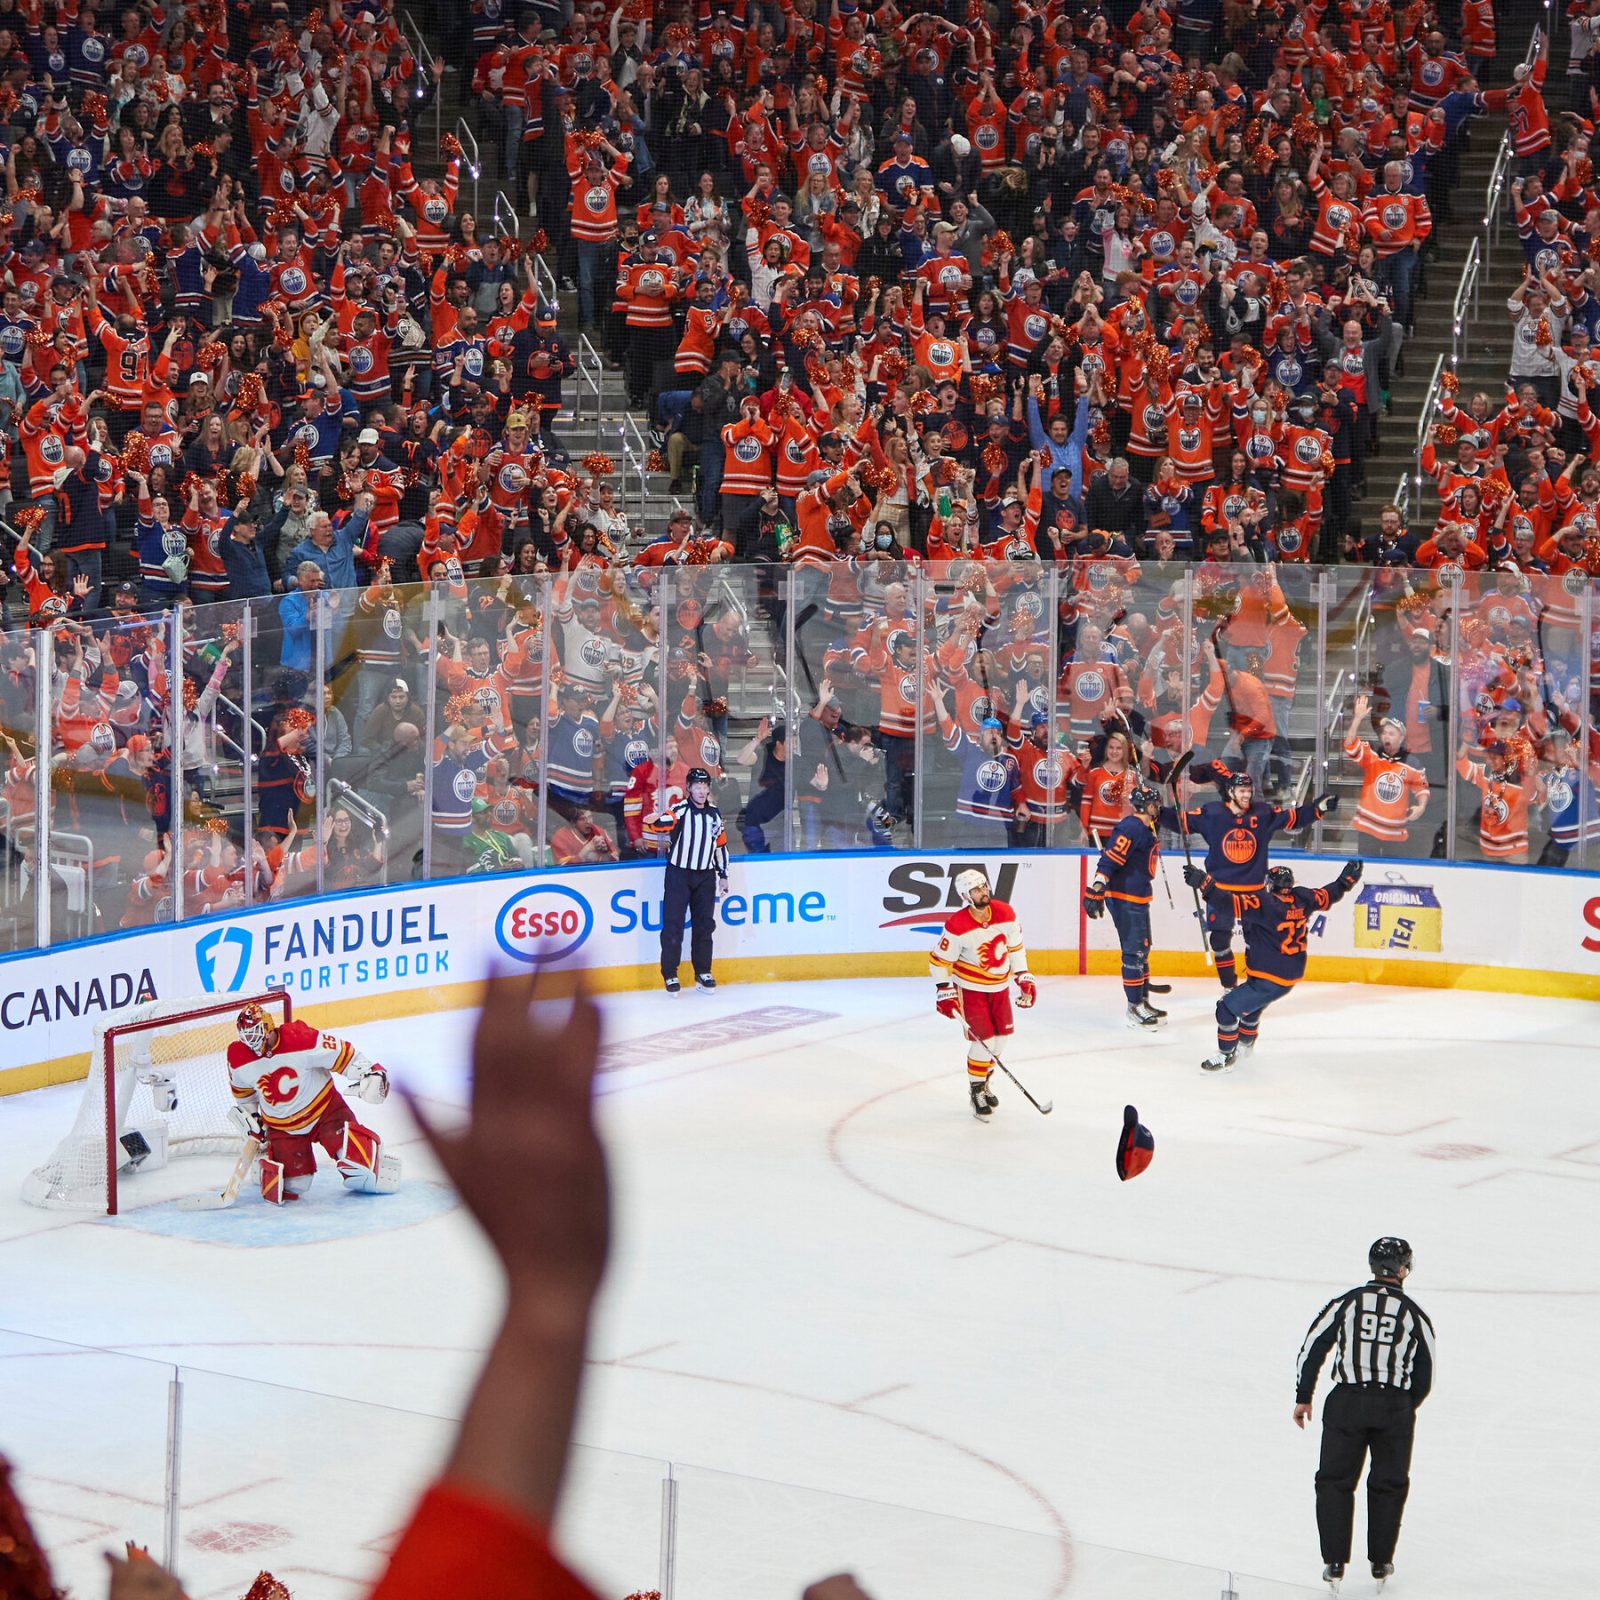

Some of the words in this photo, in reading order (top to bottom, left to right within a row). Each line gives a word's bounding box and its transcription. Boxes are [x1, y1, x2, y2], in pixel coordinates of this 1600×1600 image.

[551, 343, 559, 353] C
[983, 771, 1003, 780] OILERS
[1400, 769, 1407, 777] A
[1379, 782, 1401, 792] OILERS
[1250, 815, 1258, 829] C
[1113, 834, 1132, 856] 91
[1227, 841, 1253, 850] OILERS
[1374, 892, 1424, 905] ORIGINAL
[610, 889, 827, 934] Sueme
[264, 904, 449, 965] FANDUEL
[1277, 919, 1307, 955] 22
[1389, 917, 1416, 949] TEA
[0, 967, 158, 1031] CANADA
[322, 1033, 337, 1051] 25
[1361, 1313, 1397, 1344] 92
